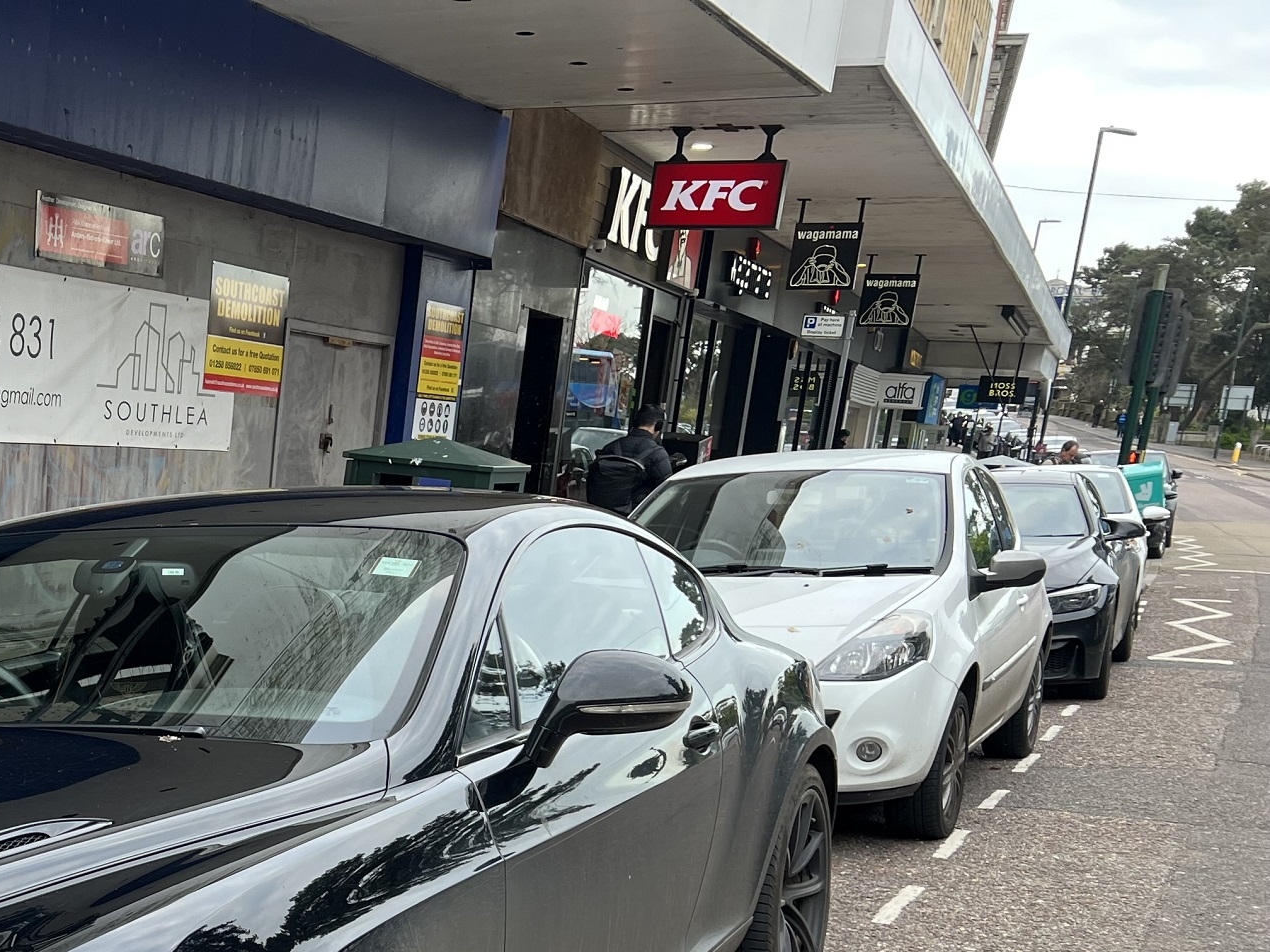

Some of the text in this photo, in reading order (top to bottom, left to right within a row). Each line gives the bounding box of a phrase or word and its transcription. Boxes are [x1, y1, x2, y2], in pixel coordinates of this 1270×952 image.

[660, 179, 764, 212] KFC
[798, 230, 859, 241] wagamama
[215, 276, 286, 308] SOUTHCOAST
[866, 279, 916, 289] wagamama
[217, 298, 280, 327] DEMOLITION
[427, 318, 462, 336] DEMOLITION
[9, 313, 55, 359] 831
[212, 344, 231, 354] Contact
[259, 351, 279, 361] Quotation
[885, 382, 916, 399] alfa
[990, 382, 1016, 390] MOSS
[103, 400, 208, 426] SOUTHLEA
[126, 429, 172, 438] DEVELOPMENTS
